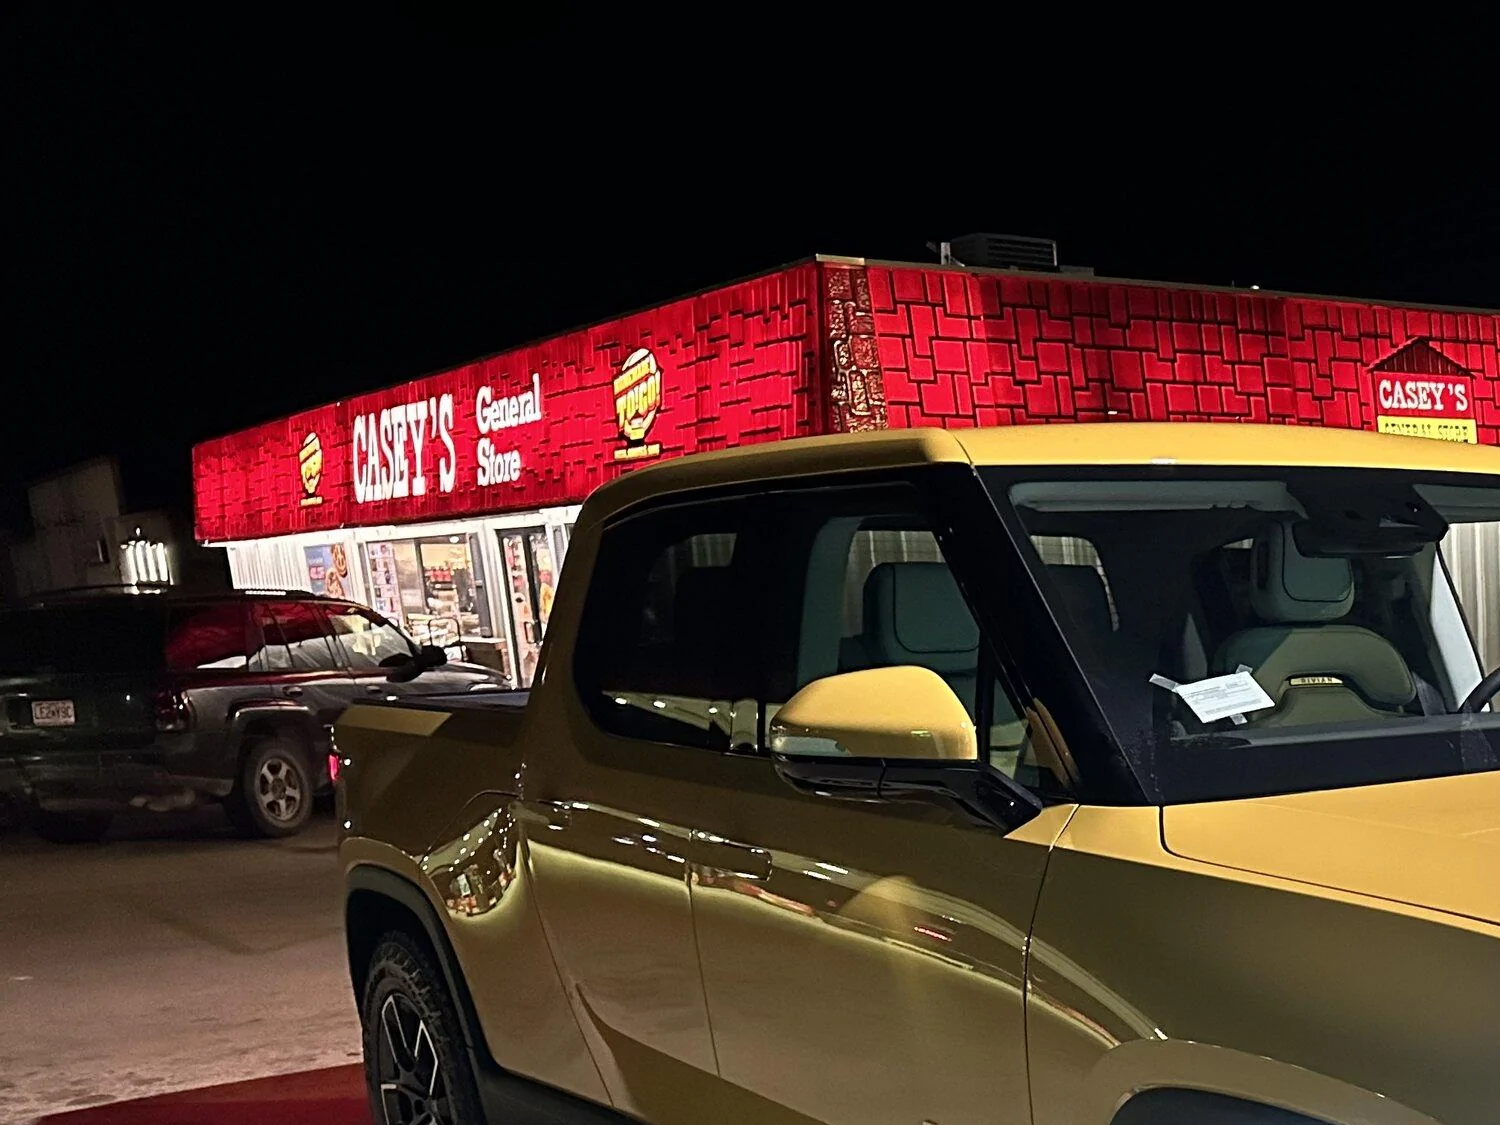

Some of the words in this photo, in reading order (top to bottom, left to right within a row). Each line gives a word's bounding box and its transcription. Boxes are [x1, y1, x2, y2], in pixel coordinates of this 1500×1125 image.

[476, 373, 542, 434] General
[1379, 379, 1468, 411] CASEY'S
[353, 393, 456, 504] CASEY'S
[477, 437, 522, 487] Store
